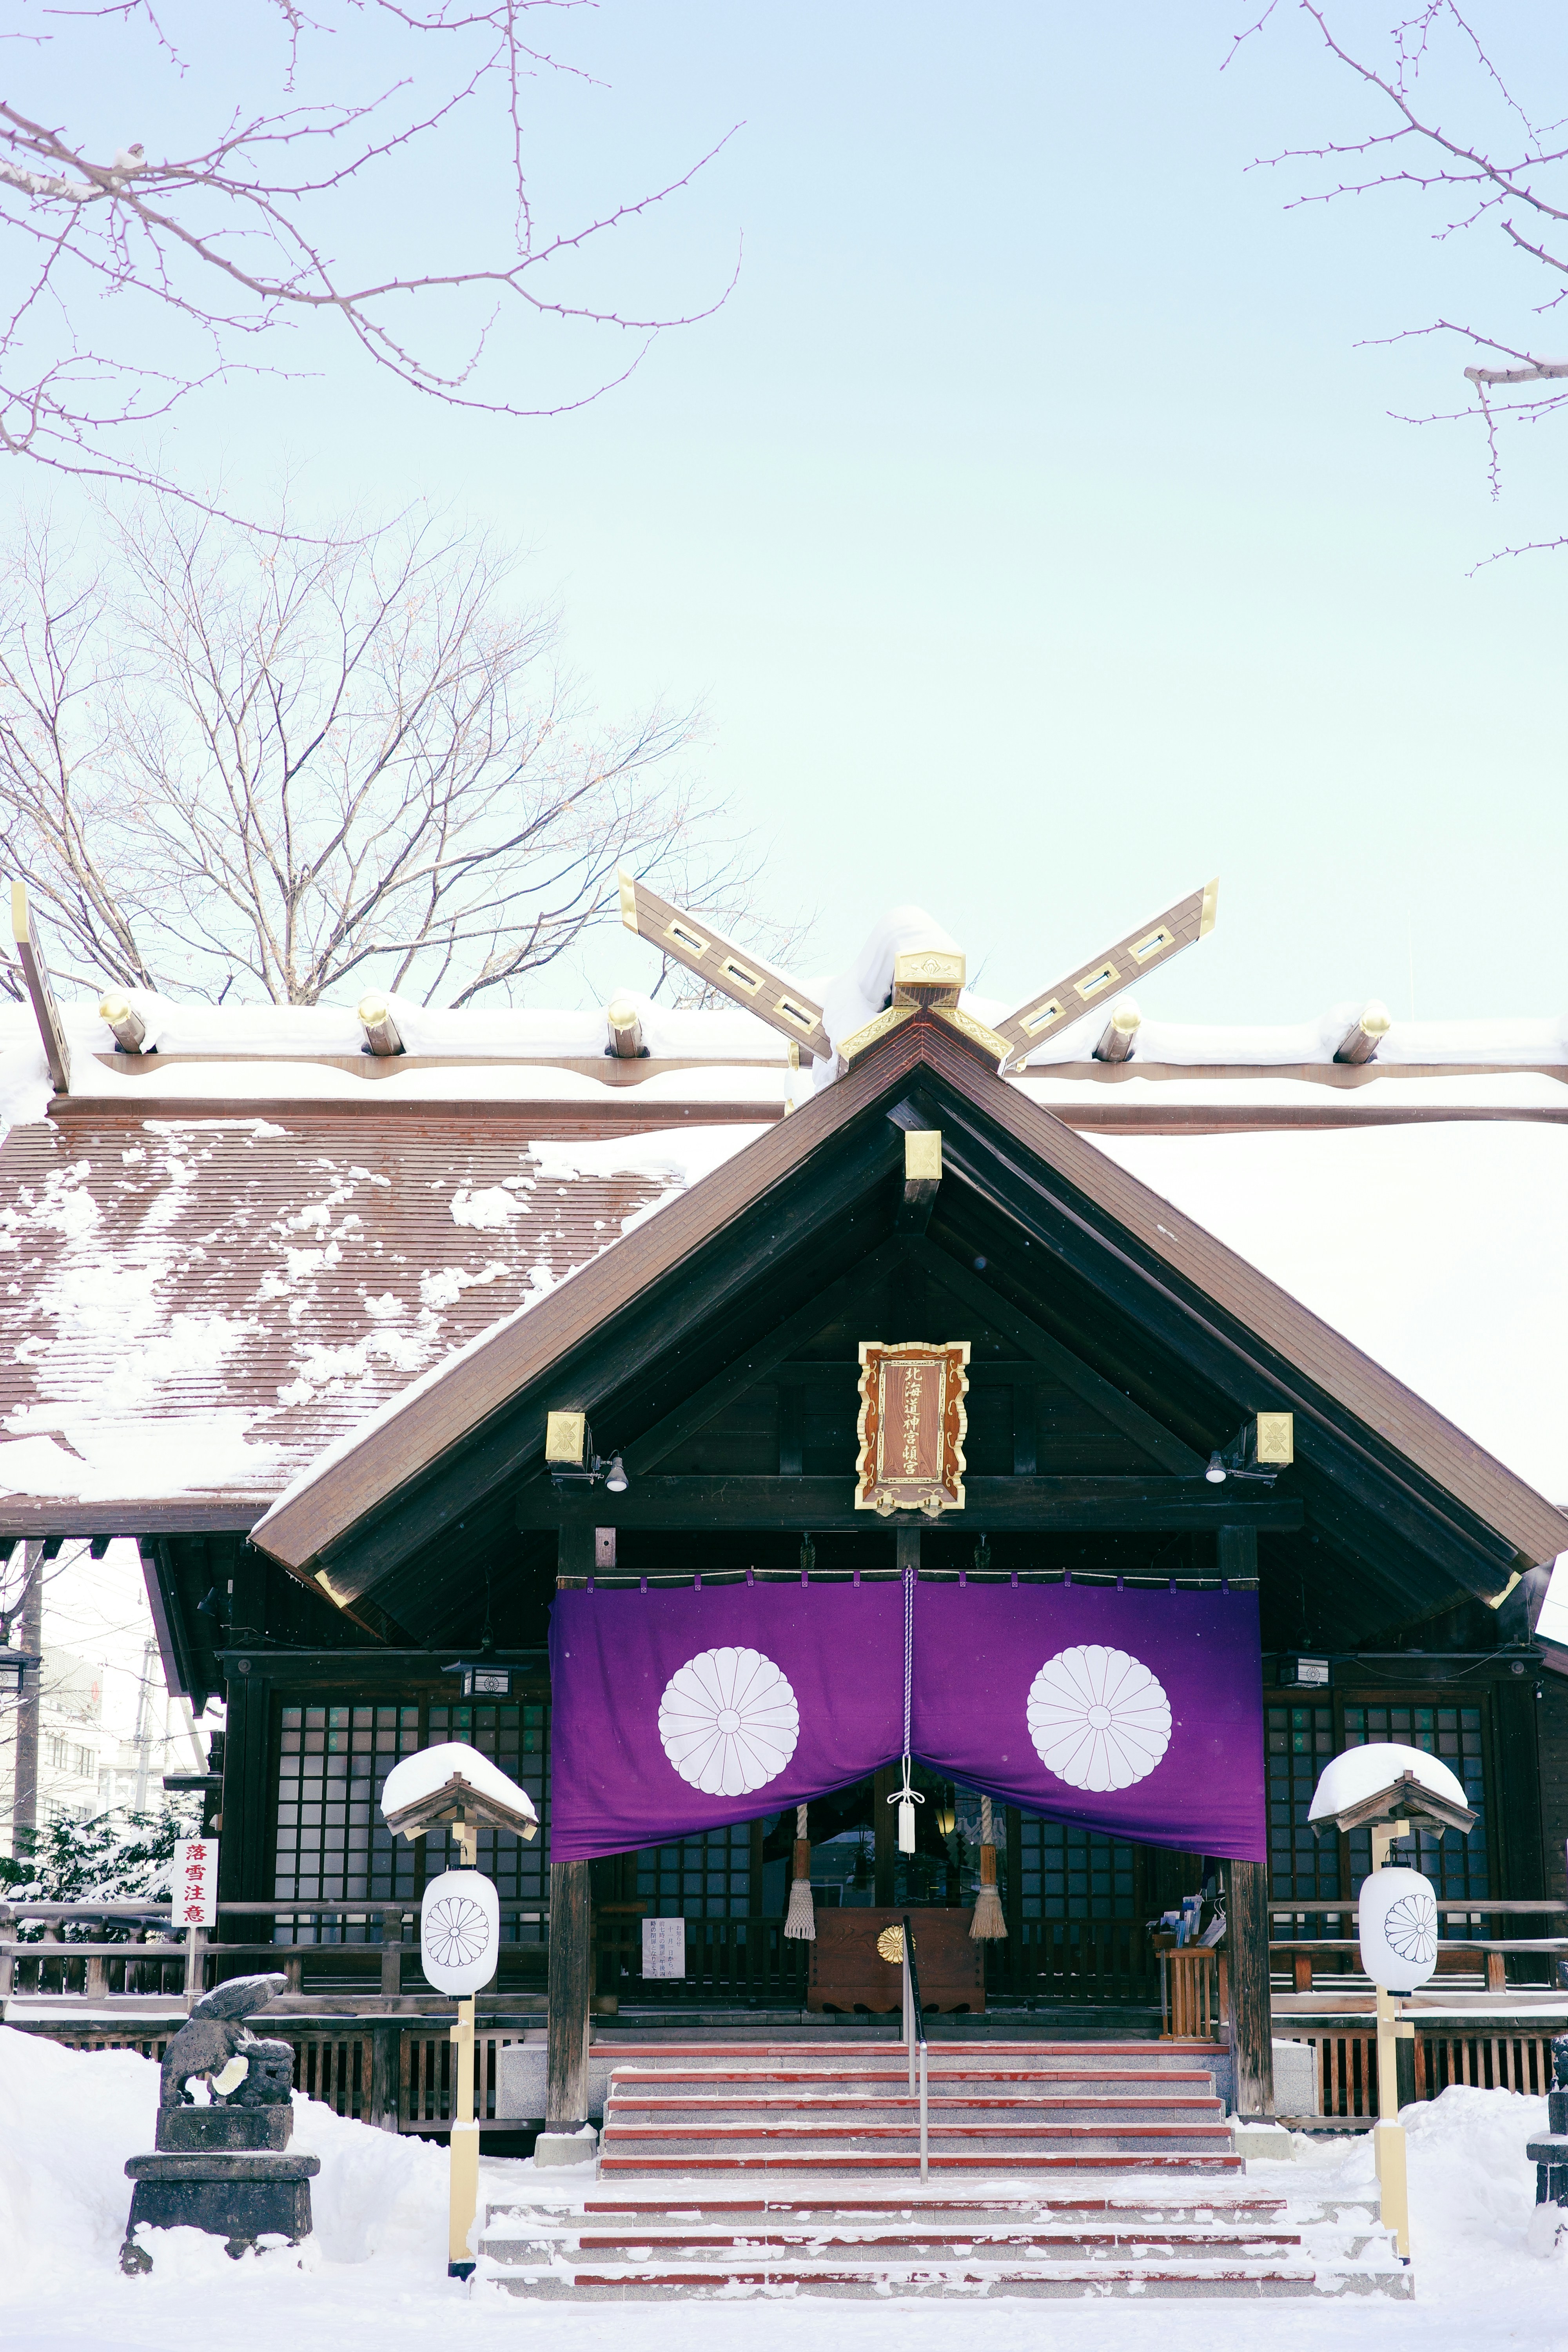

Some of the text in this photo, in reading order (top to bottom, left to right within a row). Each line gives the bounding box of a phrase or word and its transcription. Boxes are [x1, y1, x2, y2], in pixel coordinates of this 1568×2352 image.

[902, 1367, 922, 1474] 北海道神宮頓宮
[183, 1844, 207, 1922] 落雪注意
